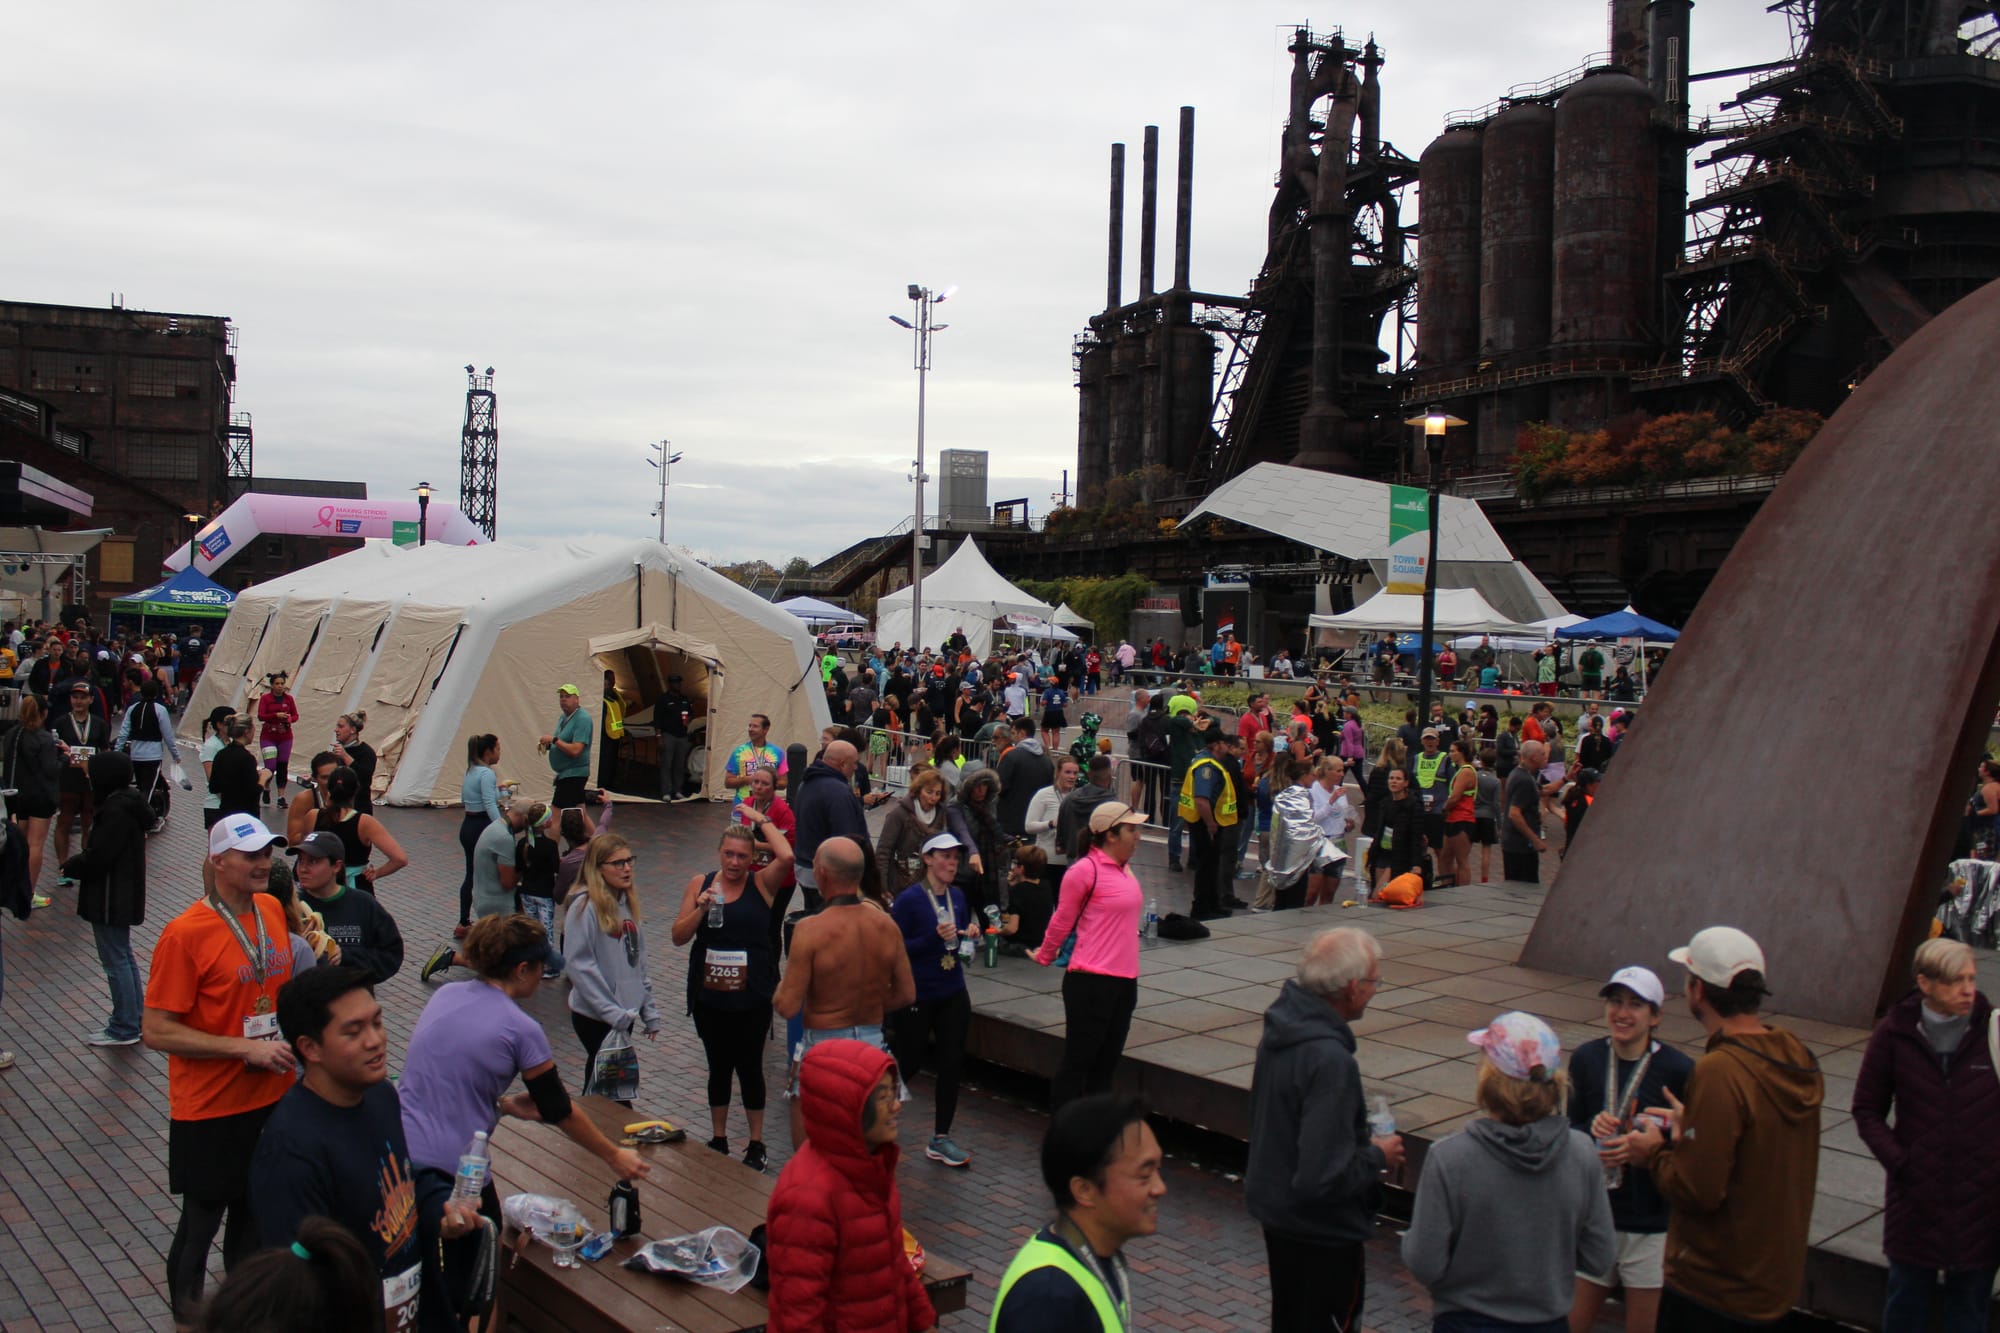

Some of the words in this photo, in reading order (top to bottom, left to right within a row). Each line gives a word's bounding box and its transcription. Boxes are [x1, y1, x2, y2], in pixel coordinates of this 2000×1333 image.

[1393, 555, 1417, 564] TOWN
[1393, 565, 1424, 575] SQUARE
[169, 589, 212, 597] Second
[192, 594, 221, 602] Wind
[710, 966, 739, 977] 2265
